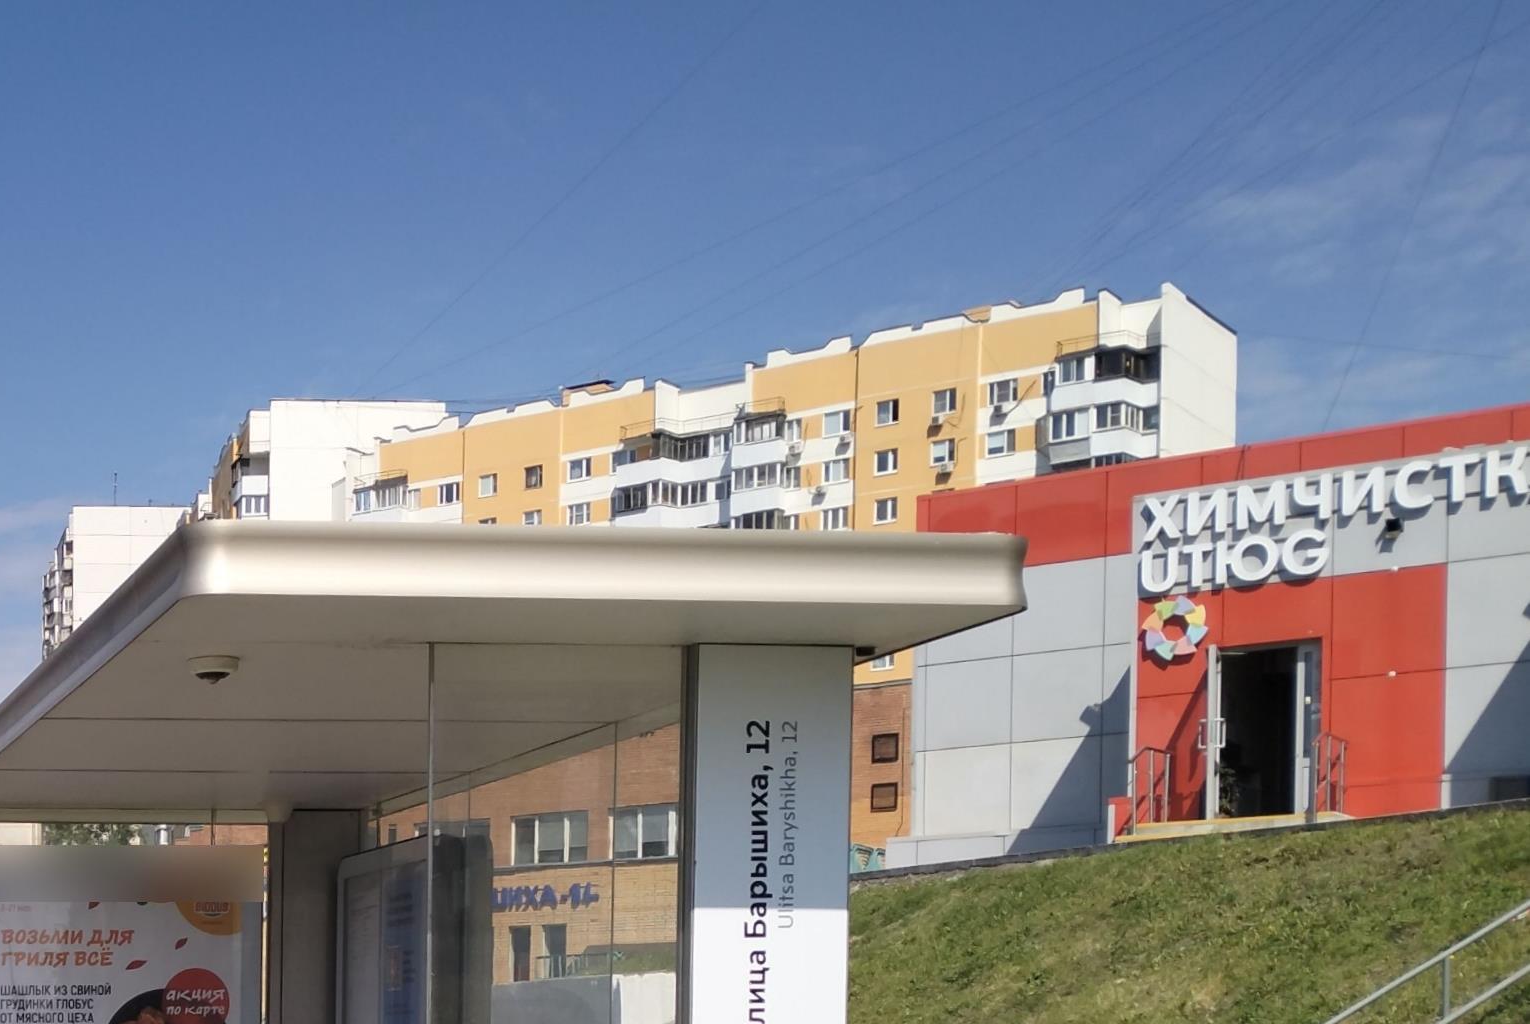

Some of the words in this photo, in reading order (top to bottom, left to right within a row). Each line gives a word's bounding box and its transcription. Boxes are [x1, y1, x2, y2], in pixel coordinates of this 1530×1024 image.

[1143, 446, 1530, 542] ХИМЧИСТК
[746, 720, 770, 754] 12
[781, 720, 798, 743] 12
[779, 752, 799, 866] Baryshikha,
[744, 765, 774, 938] Барышиха,
[777, 873, 794, 929] Ulitsa
[1, 928, 83, 946] ВОЗЬМИ
[87, 929, 135, 947] ДЛЯ
[1, 951, 70, 968] ГРИЛЯ
[74, 947, 114, 967] ВСЁ
[0, 984, 51, 996] ШАШЛЫК
[54, 984, 68, 996] ИЗ
[71, 982, 111, 996] СВИНОЙ
[0, 999, 53, 1012] ГРУДИНКИ
[56, 998, 94, 1010] ГЛОБУС
[166, 1006, 181, 1015] по
[184, 1005, 226, 1018] карте
[0, 1013, 13, 1024] ОТ
[16, 1012, 64, 1024] МЯСНОГО
